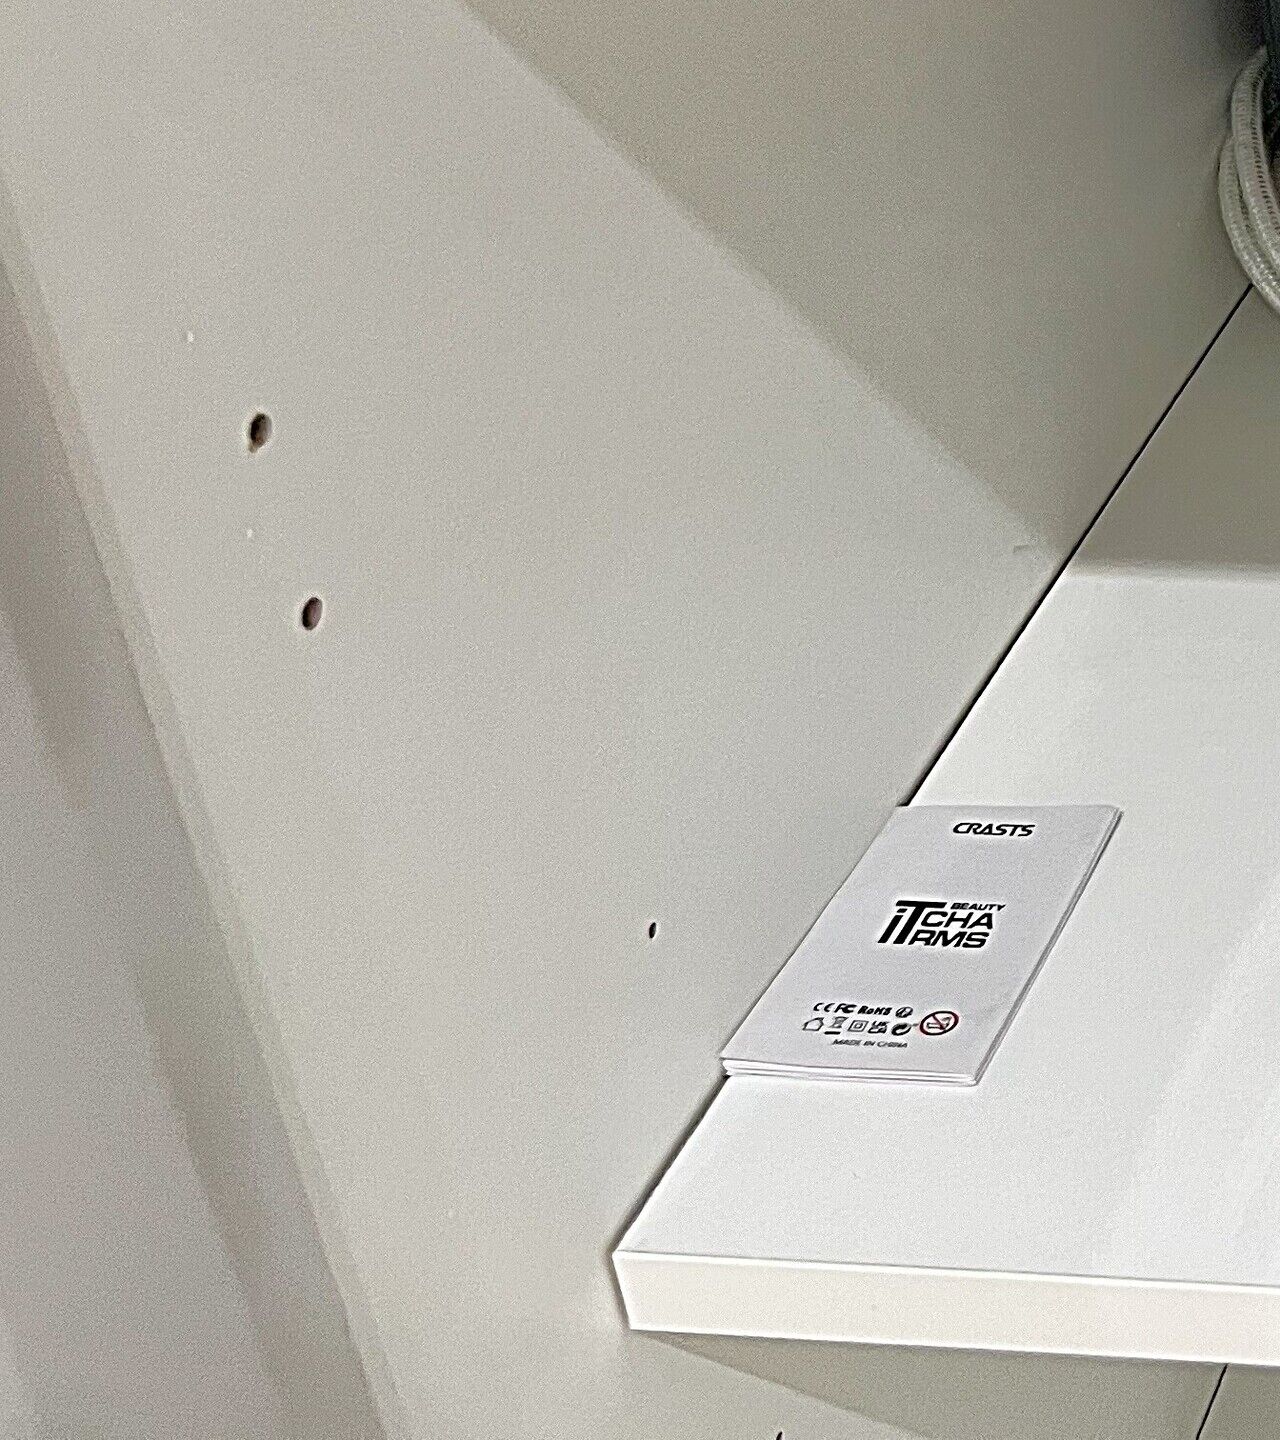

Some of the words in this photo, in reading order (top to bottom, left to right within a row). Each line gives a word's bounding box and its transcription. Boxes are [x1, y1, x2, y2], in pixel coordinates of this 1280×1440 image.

[952, 822, 1036, 837] CRASTS
[950, 902, 1006, 912] BEAUTY
[920, 912, 994, 929] CHA
[908, 930, 990, 948] RMS
[857, 1005, 893, 1016] RoHS
[832, 1038, 862, 1046] MADE
